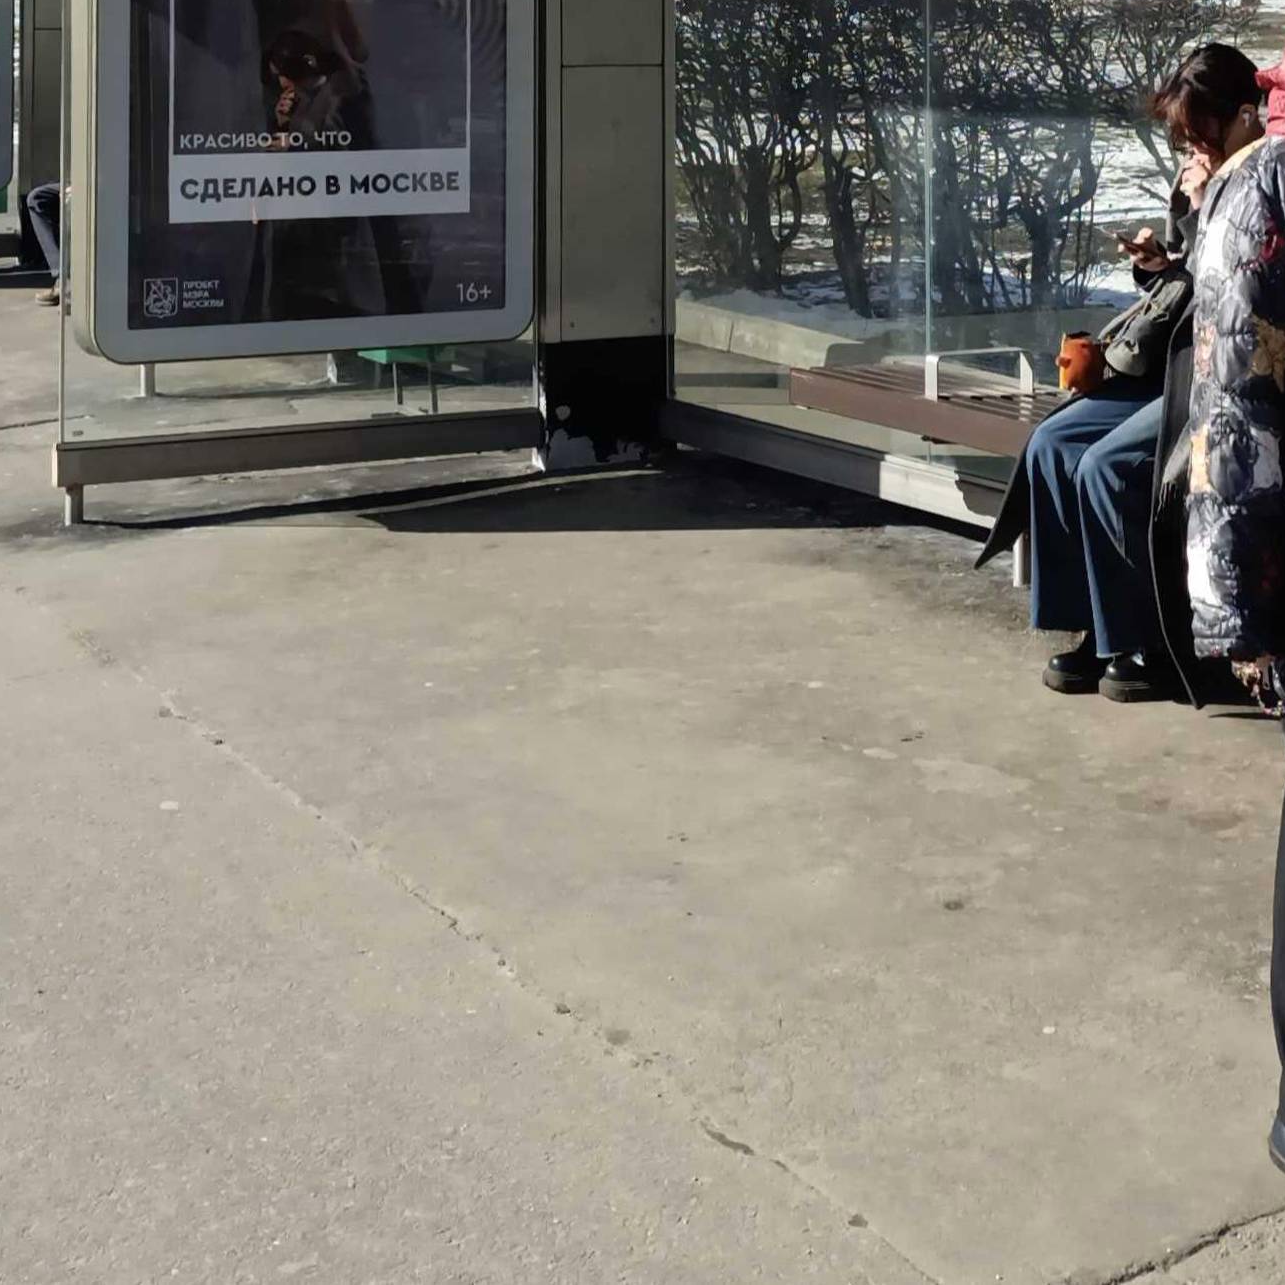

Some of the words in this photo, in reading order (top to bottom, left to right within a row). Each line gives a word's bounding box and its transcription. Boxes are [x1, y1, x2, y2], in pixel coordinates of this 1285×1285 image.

[179, 132, 273, 150] КРАСИВО
[279, 131, 309, 150] ТО,
[314, 130, 352, 147] ЧТО
[179, 174, 317, 204] СДЕЛАНО
[325, 174, 340, 196] В
[349, 170, 461, 195] МОСКВЕ
[182, 280, 221, 290] ПРОЕКТ
[456, 281, 493, 304] 16+
[182, 298, 225, 309] МОСКВЫ
